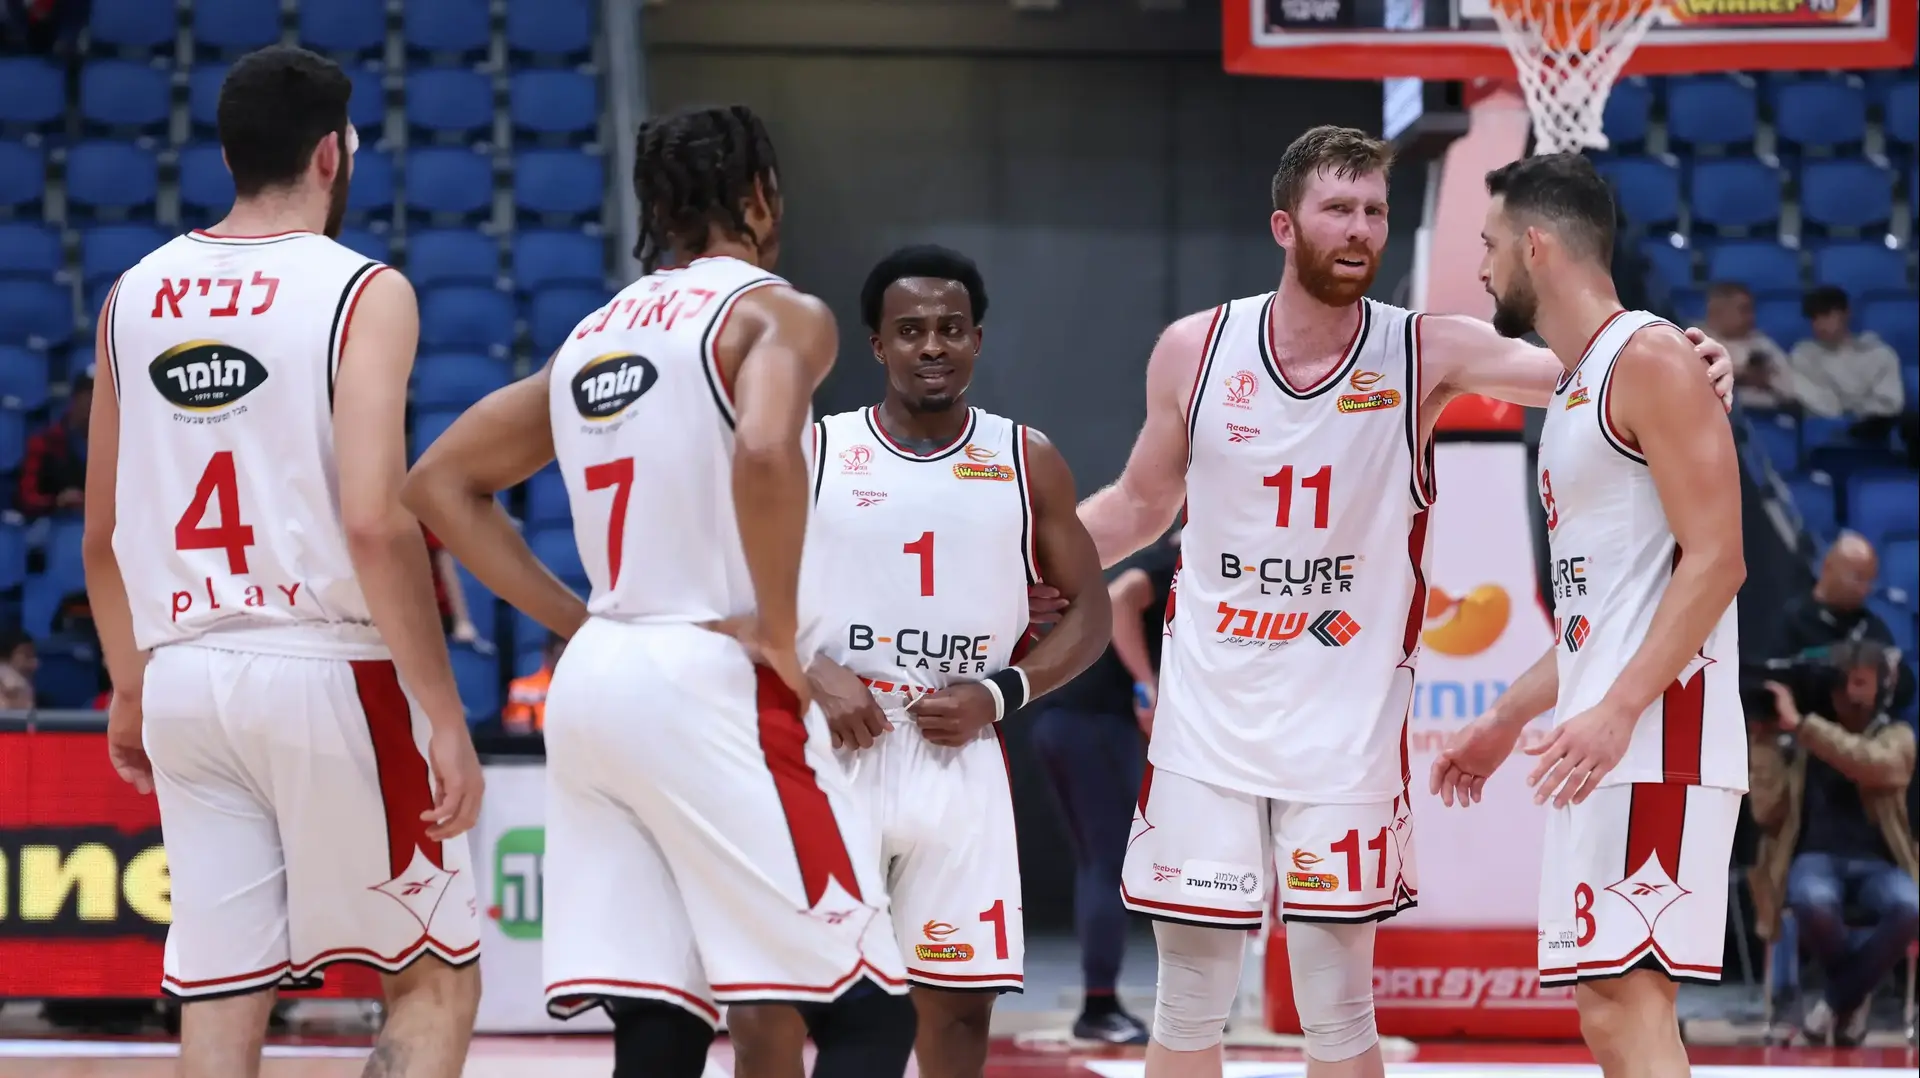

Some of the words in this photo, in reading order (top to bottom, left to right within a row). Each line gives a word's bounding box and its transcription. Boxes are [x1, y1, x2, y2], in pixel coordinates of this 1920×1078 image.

[151, 270, 280, 319] לביא
[1342, 399, 1383, 410] Winner
[1226, 422, 1261, 435] Reebok
[959, 467, 999, 478] Winner
[852, 489, 888, 498] Reebok
[1263, 465, 1333, 529] 11
[174, 451, 255, 575] 4
[584, 457, 635, 592] 7
[903, 531, 935, 597] 1
[1220, 553, 1356, 585] B-CURE
[1552, 556, 1587, 588] URE
[1260, 580, 1352, 597] LASER
[1554, 584, 1588, 599] SER
[1216, 601, 1309, 640] שובל
[849, 624, 991, 661] B-CURE
[896, 655, 986, 674] LASER
[1330, 825, 1388, 892] 11
[1152, 862, 1182, 875] Reebok
[1214, 871, 1239, 882] אלמוג
[1186, 877, 1212, 888] מערב
[1213, 880, 1238, 891] כרמל
[1290, 876, 1320, 888] Winner
[979, 899, 1009, 960] 1
[1560, 940, 1576, 949] רמל
[920, 948, 958, 959] Winner
